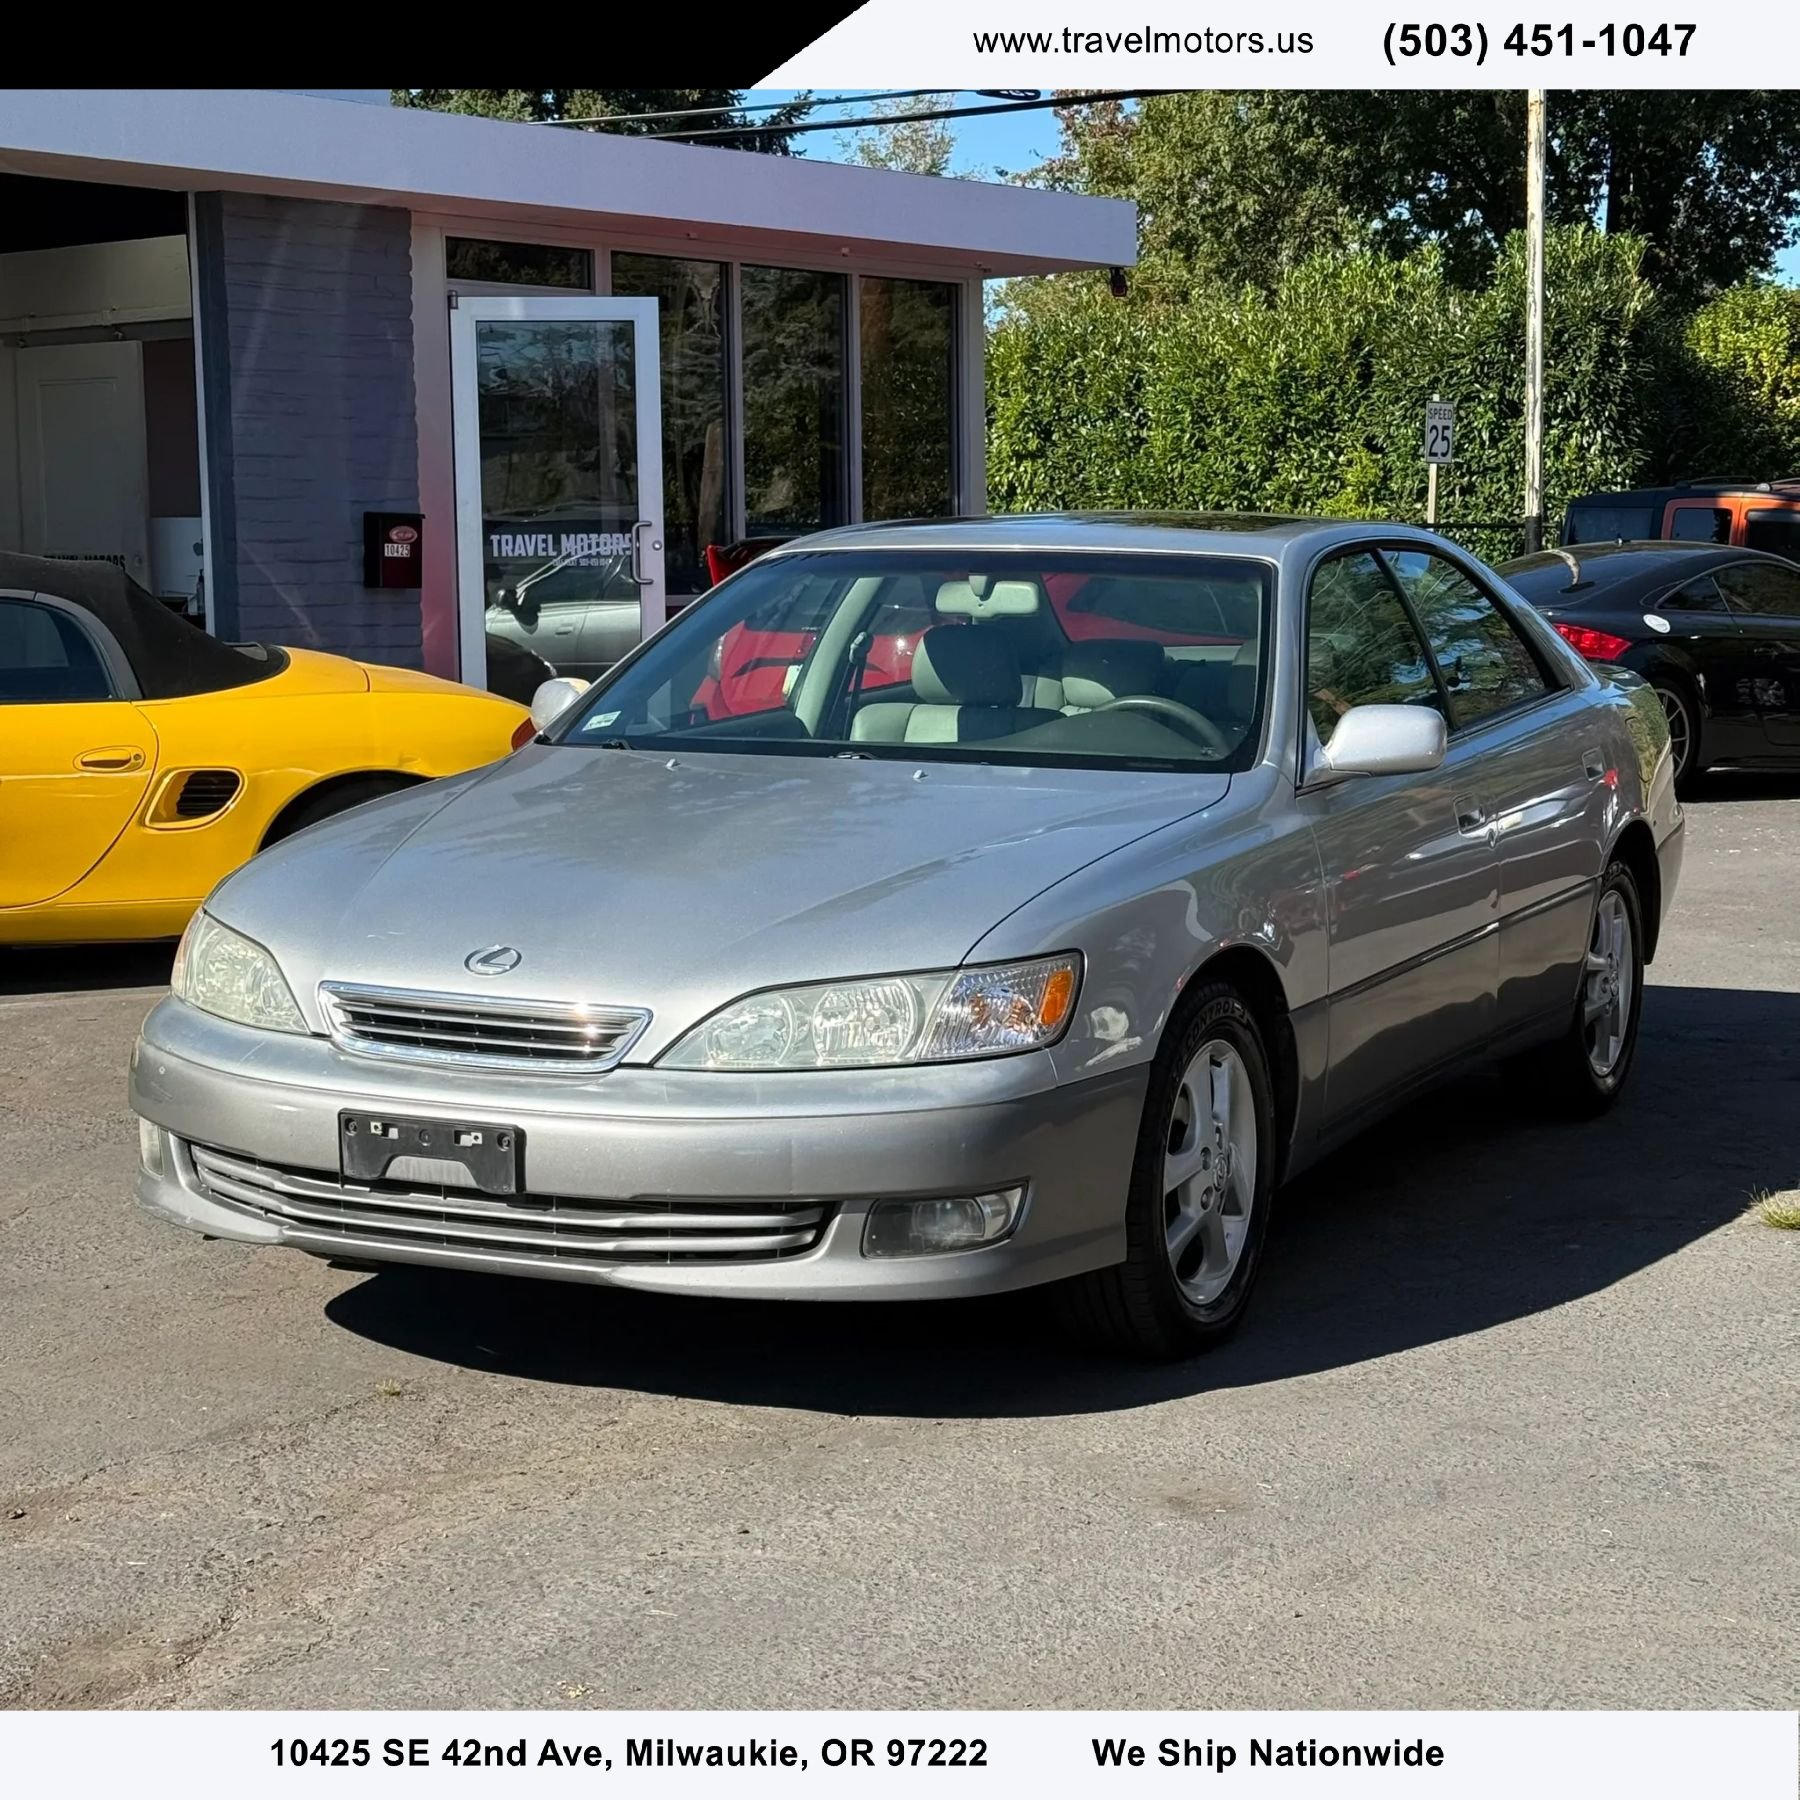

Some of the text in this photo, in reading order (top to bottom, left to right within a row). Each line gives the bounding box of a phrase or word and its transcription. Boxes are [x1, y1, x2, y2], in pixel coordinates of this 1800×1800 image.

[1428, 408, 1453, 420] SPEED
[1428, 424, 1451, 458] 25
[385, 544, 410, 557] 10425
[490, 532, 633, 557] TRAVEL MOTORS
